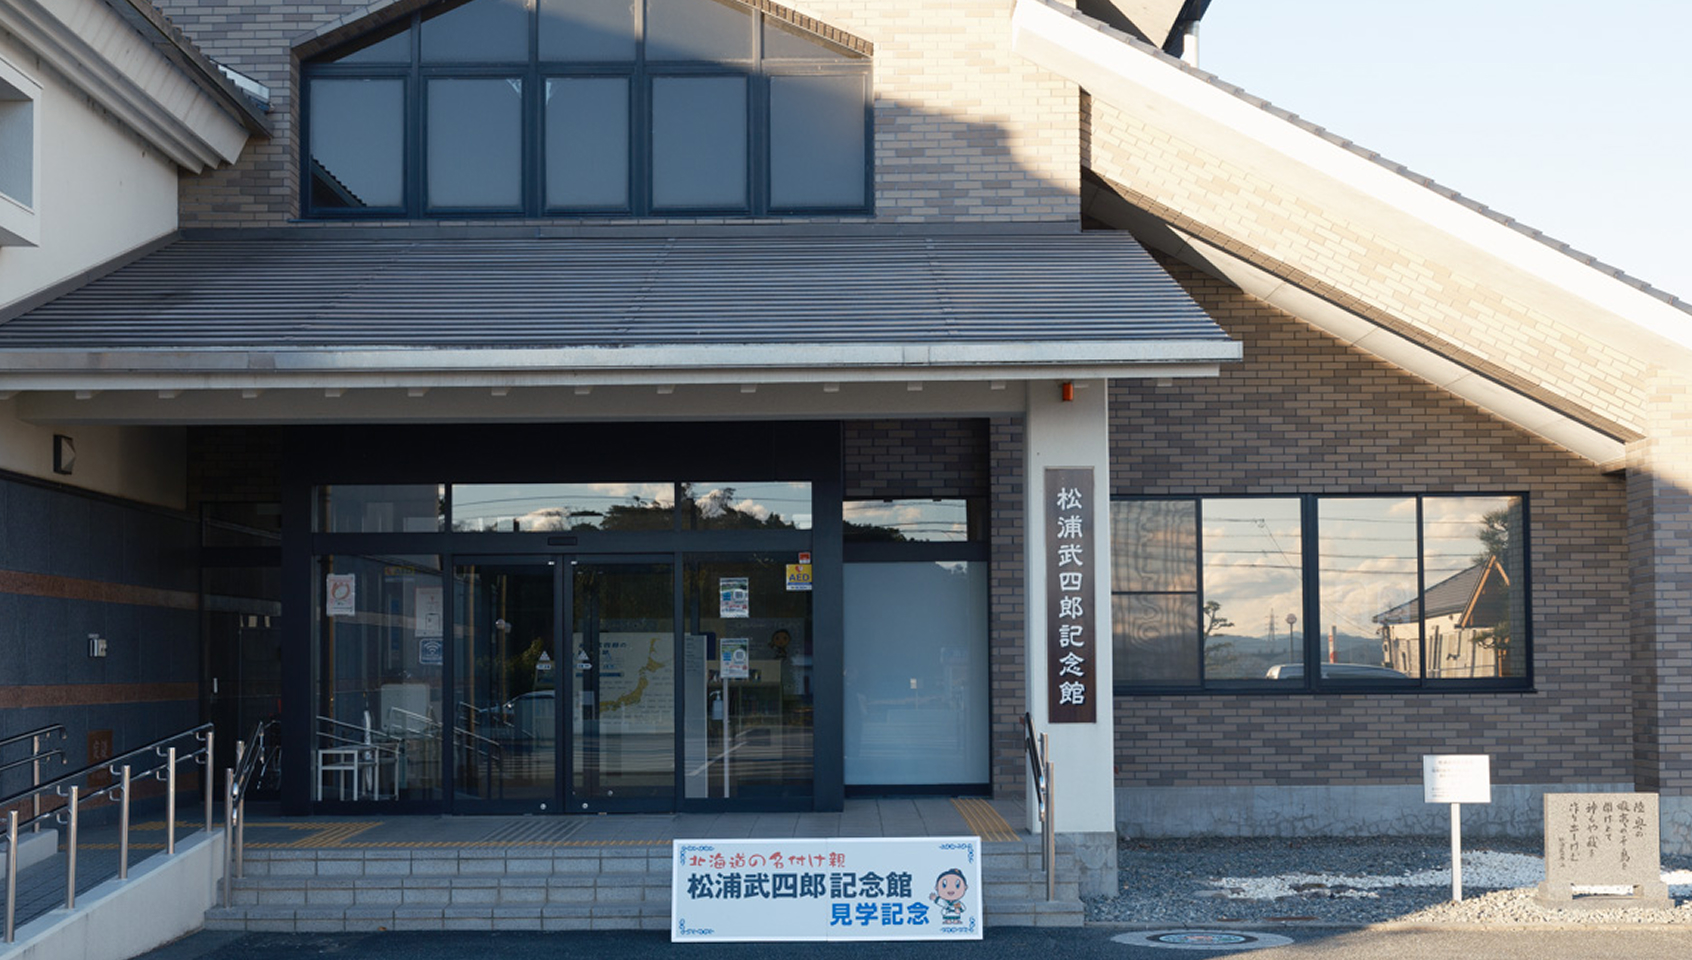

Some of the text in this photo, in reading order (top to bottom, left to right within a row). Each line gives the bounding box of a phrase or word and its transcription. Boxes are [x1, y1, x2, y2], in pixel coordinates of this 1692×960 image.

[789, 573, 810, 582] AED
[1056, 487, 1086, 705] 松浦武四郎記念館
[688, 852, 846, 869] 北海道の名付け親
[687, 871, 912, 900] 松浦武四郎記念館
[829, 902, 930, 926] 見学記念
